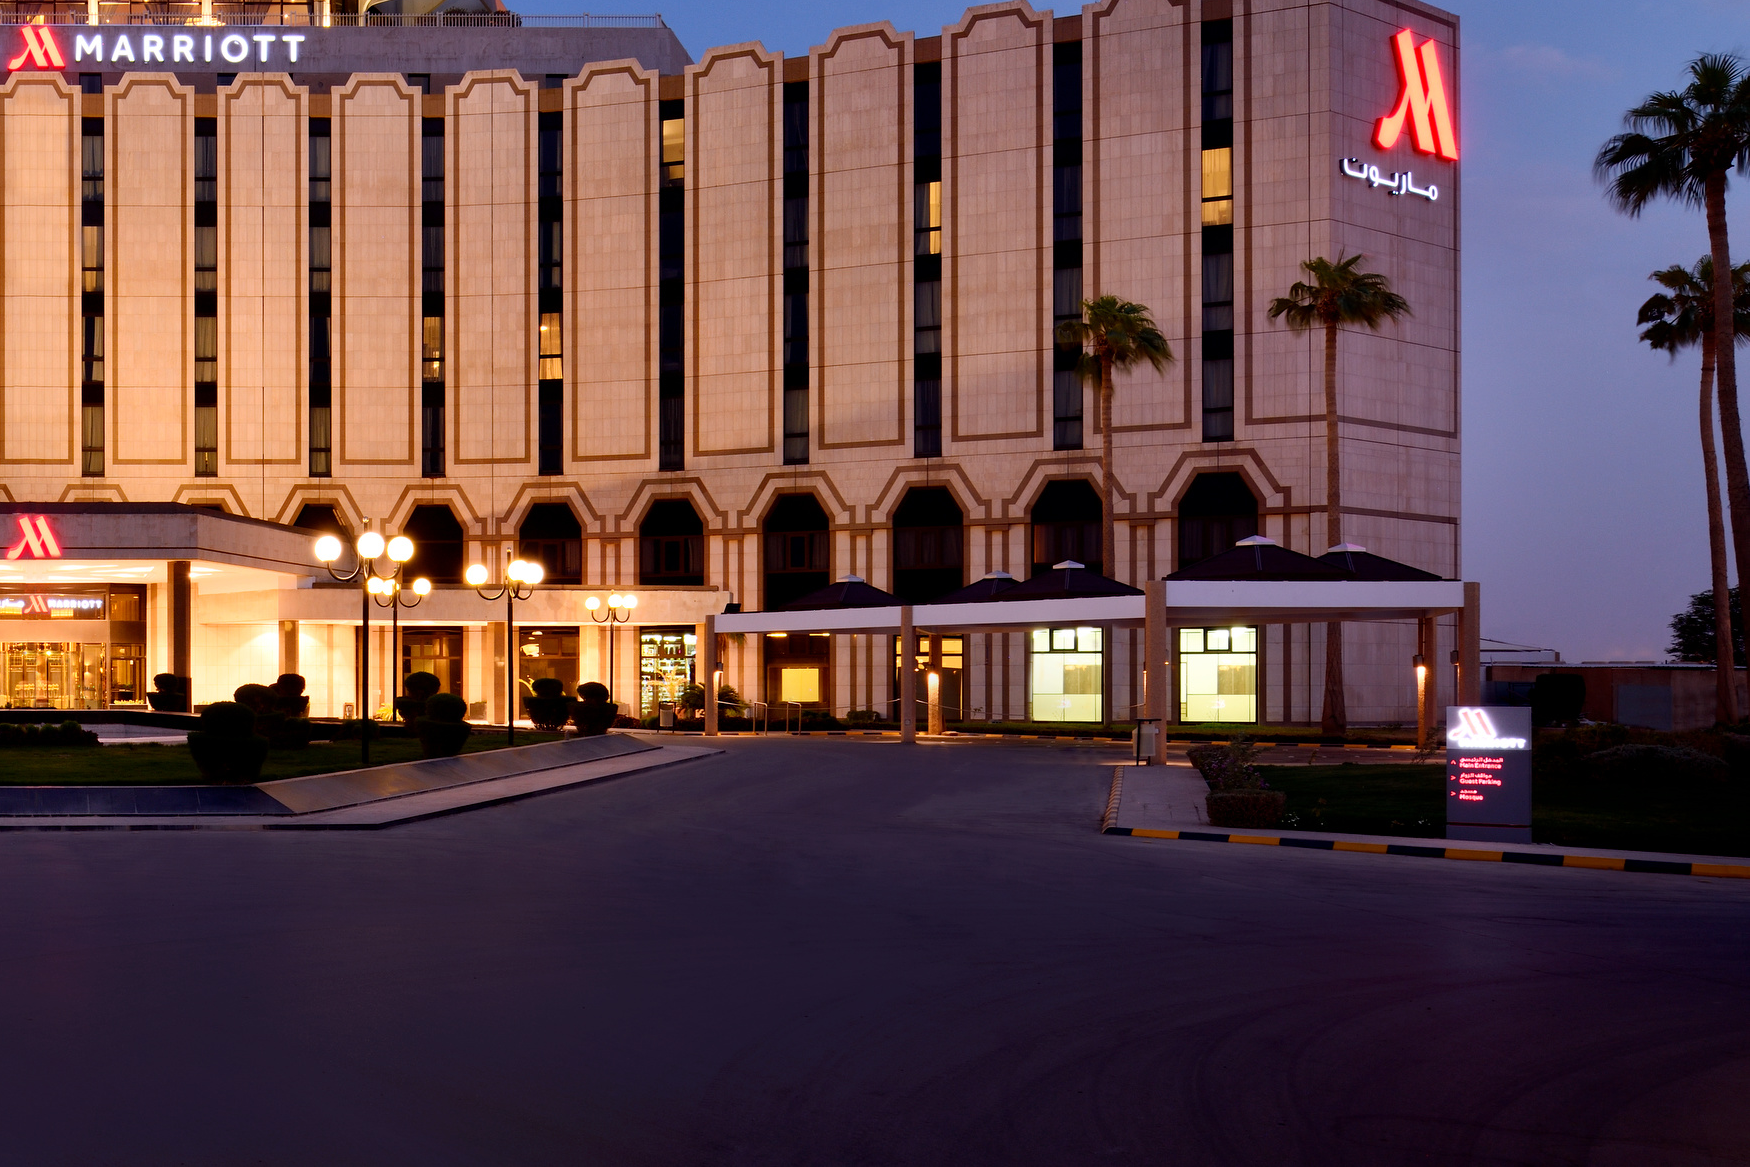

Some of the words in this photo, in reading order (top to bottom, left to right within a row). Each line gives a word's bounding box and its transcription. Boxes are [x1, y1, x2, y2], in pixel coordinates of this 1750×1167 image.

[75, 34, 306, 64] MARRIOTT
[1340, 157, 1439, 201] ماريوت
[47, 599, 103, 609] MARRIOTT
[1478, 779, 1502, 787] Parking
